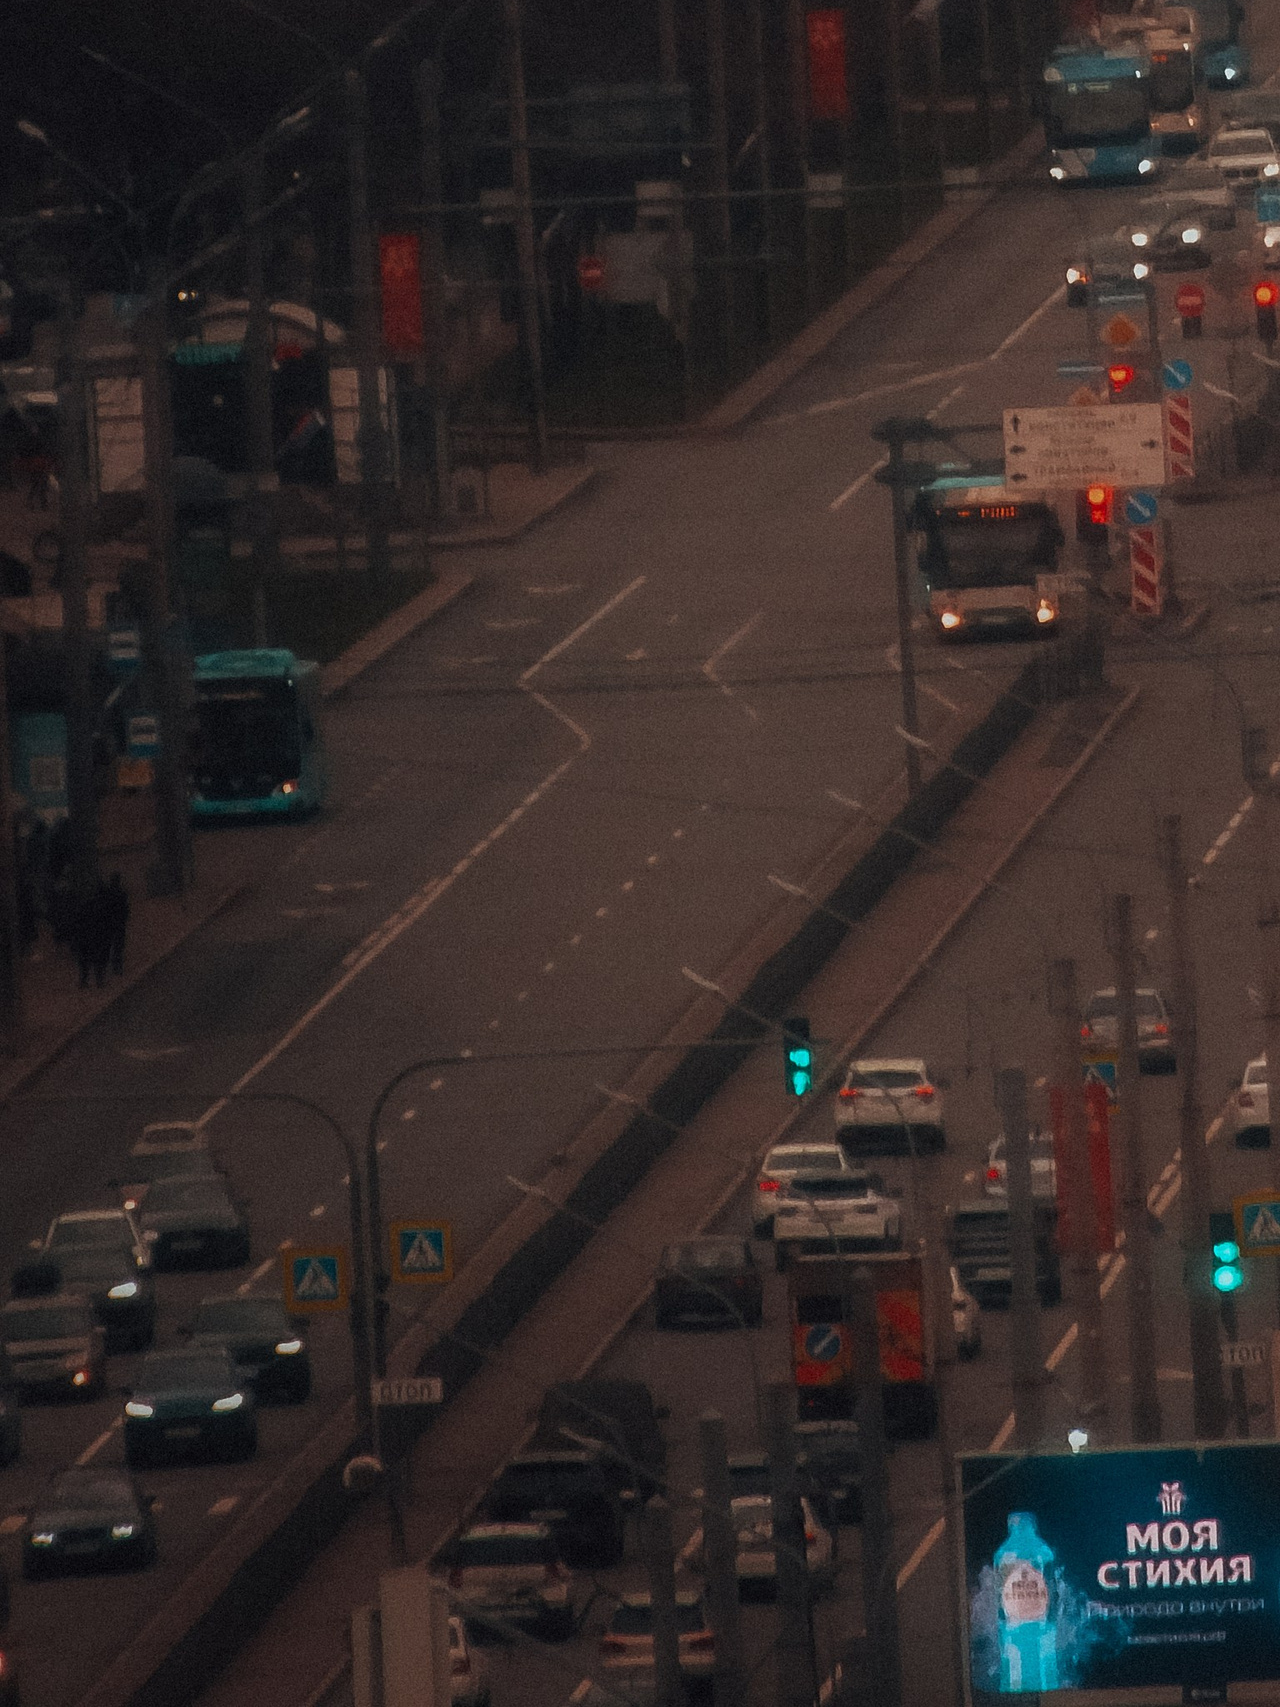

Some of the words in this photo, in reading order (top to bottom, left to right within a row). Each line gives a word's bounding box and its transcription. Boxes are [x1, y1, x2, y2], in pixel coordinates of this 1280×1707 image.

[1125, 1518, 1220, 1557] МОЯ
[1096, 1554, 1254, 1592] СТИХИЯ
[1188, 1597, 1265, 1616] внутри
